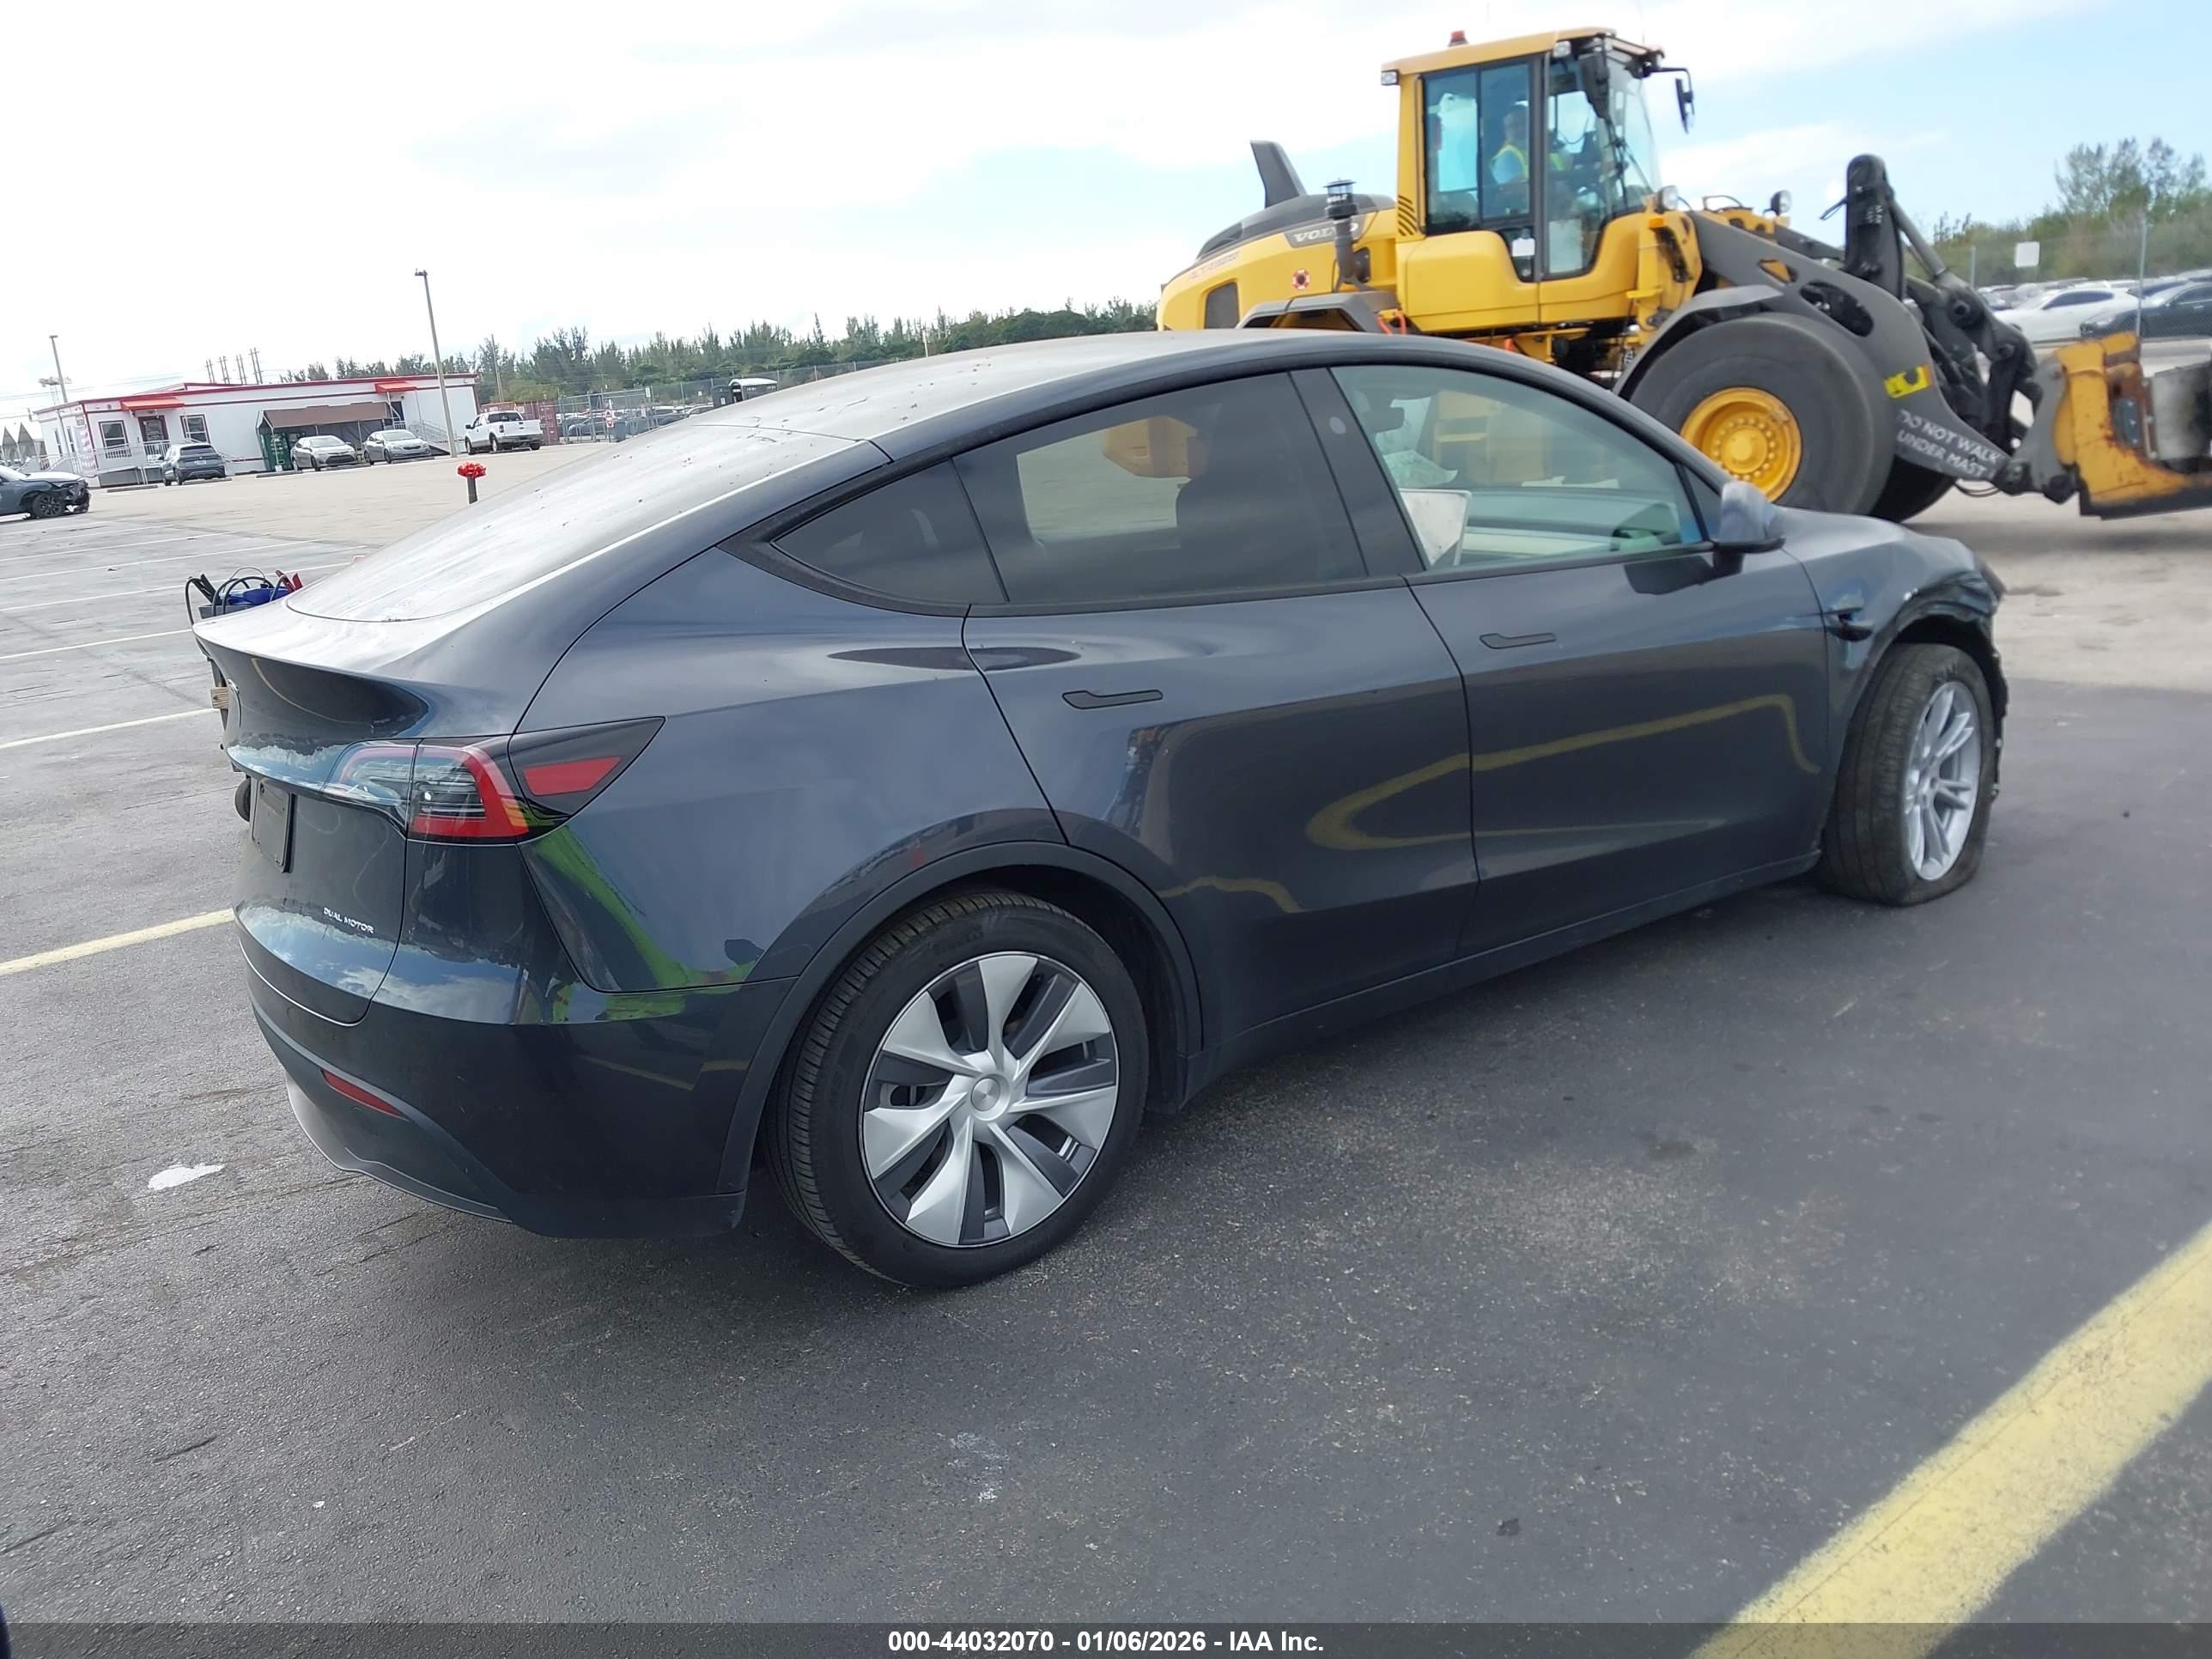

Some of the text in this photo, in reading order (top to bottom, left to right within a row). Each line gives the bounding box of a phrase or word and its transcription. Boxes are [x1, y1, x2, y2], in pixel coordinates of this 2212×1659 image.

[1898, 429, 1987, 477] UNDER MAST
[1923, 422, 1957, 445] NOT
[1958, 436, 2006, 464] WALK
[324, 907, 374, 934] DUAL MOTOR
